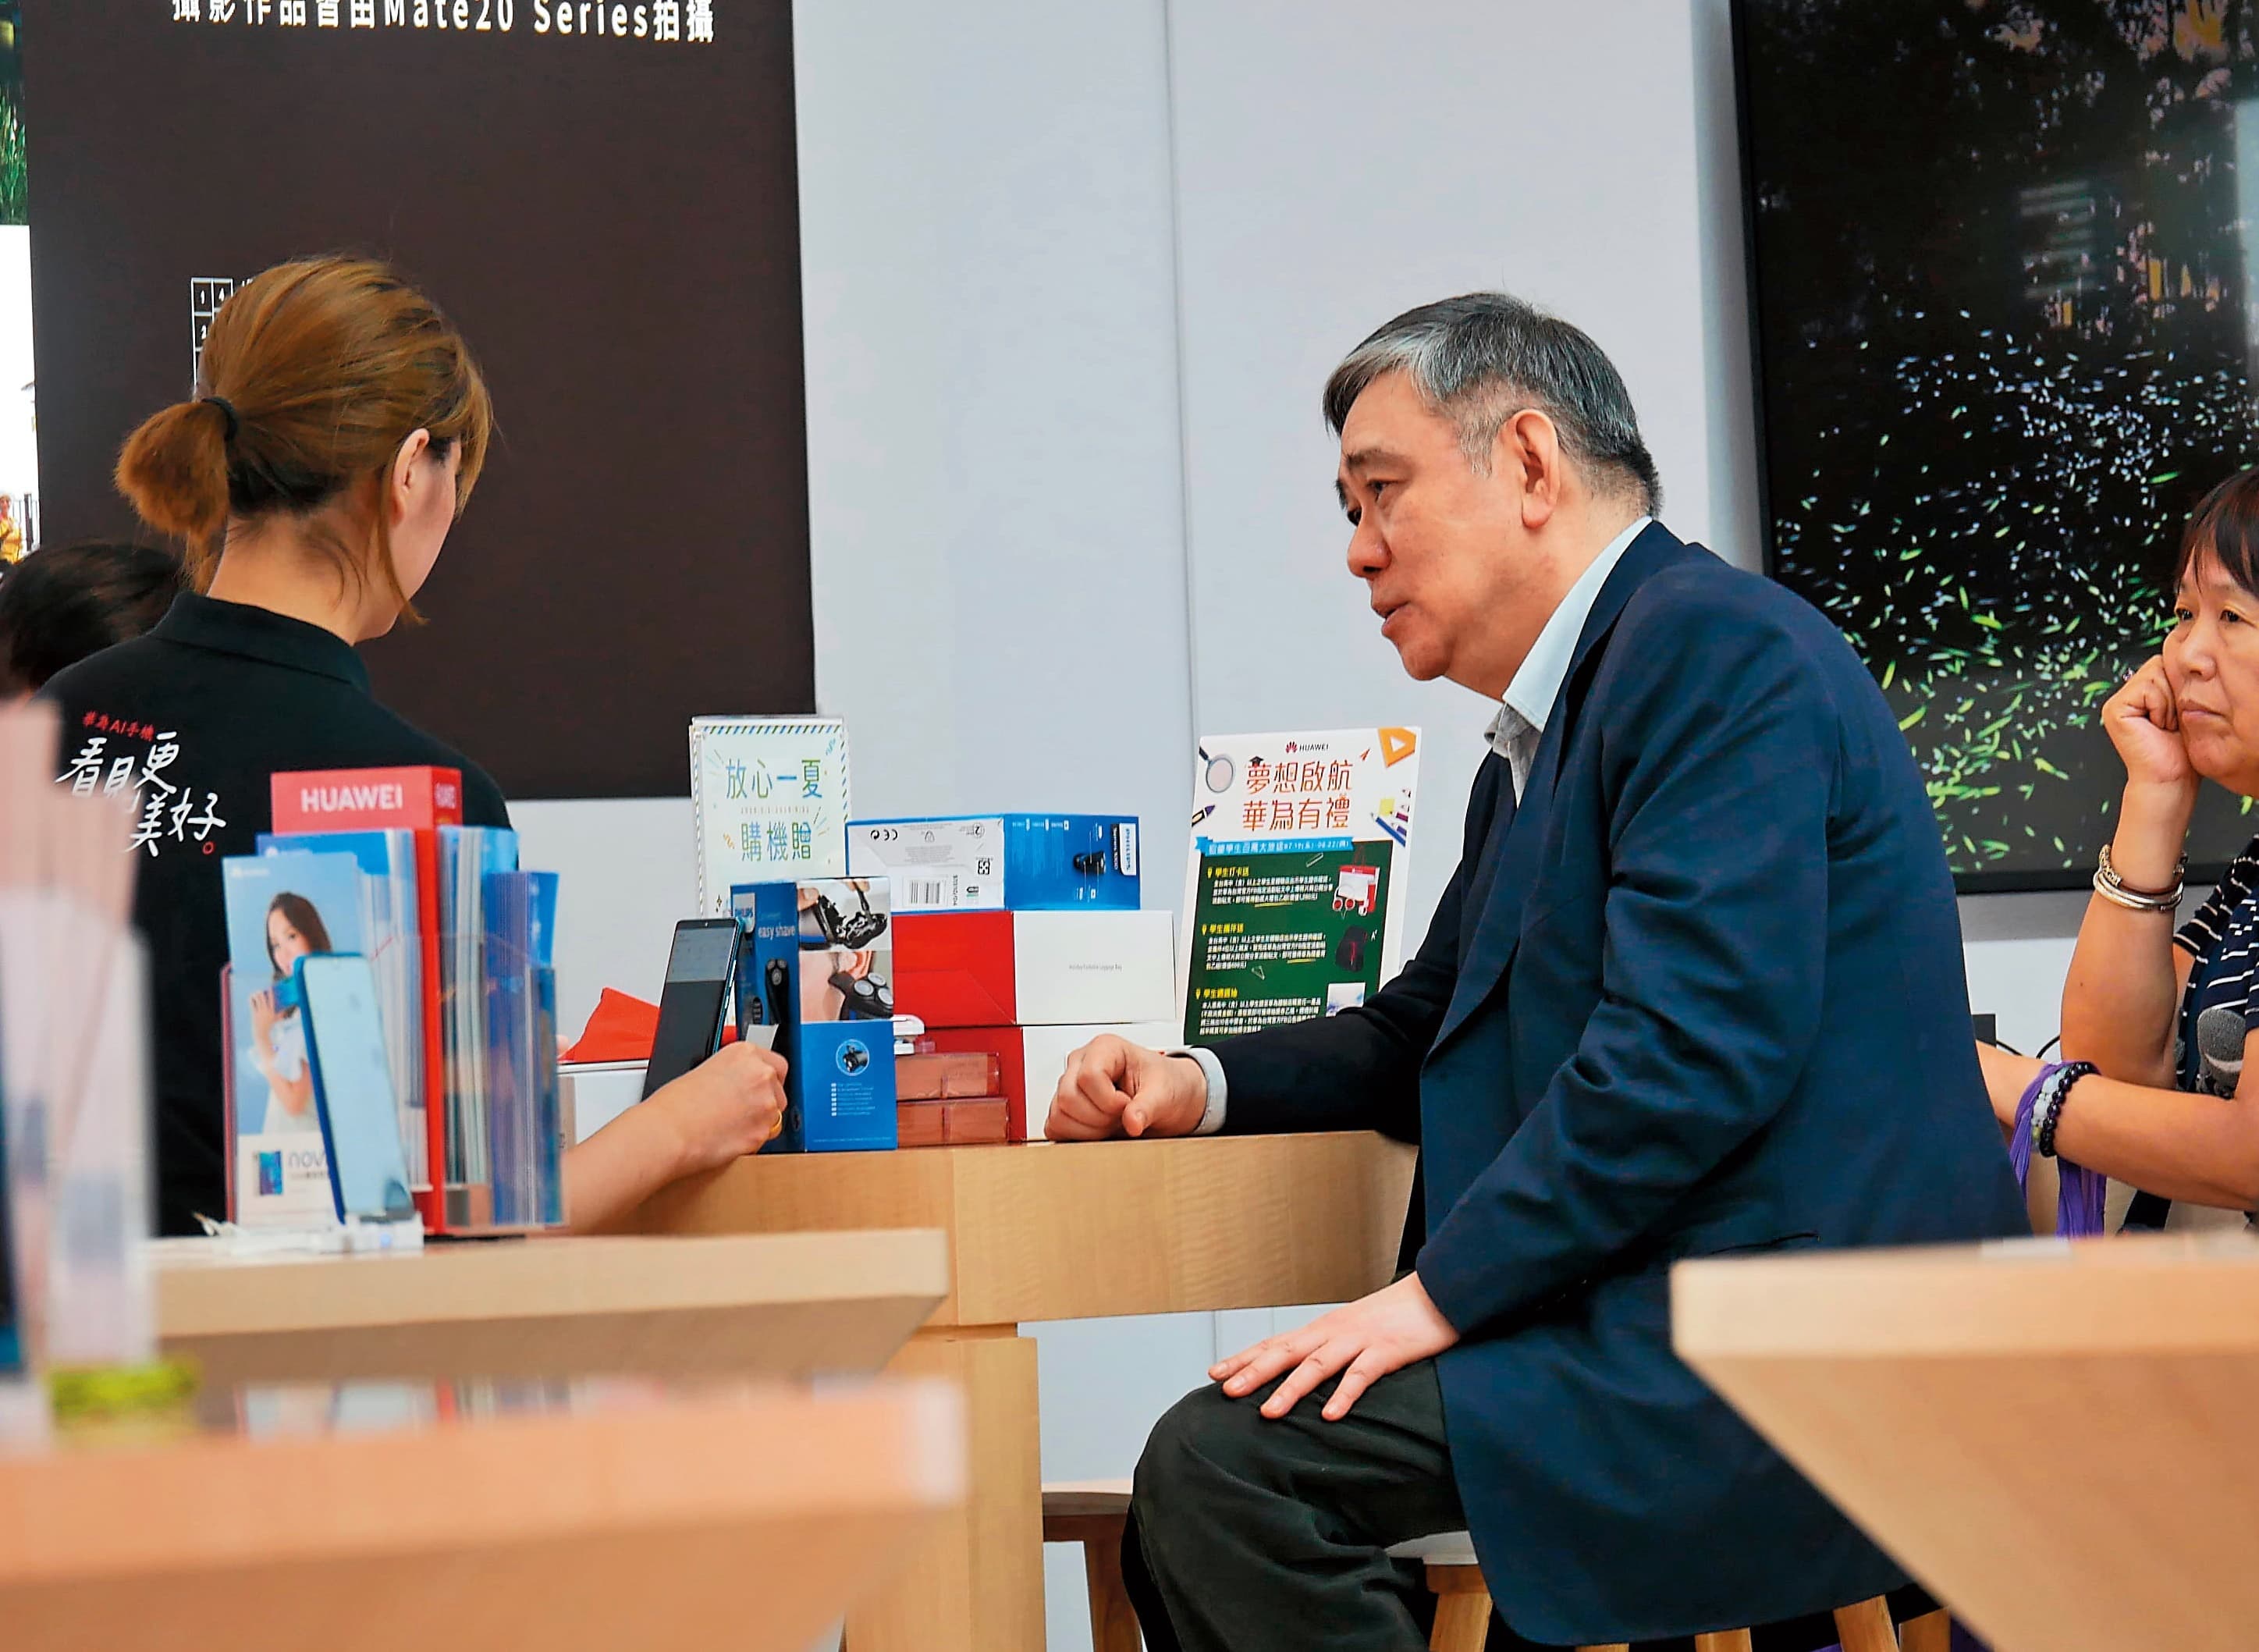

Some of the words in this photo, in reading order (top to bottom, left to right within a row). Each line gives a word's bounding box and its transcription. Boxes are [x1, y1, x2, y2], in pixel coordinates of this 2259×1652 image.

[1299, 743, 1329, 752] HUAWEI
[726, 758, 822, 800] 放心一夏
[1246, 759, 1353, 794] 夢想啟航
[300, 783, 403, 813] HUAWEI
[1242, 794, 1351, 832] 華為有禮
[741, 821, 812, 862] 購機贈
[758, 926, 774, 940] easy
[775, 922, 796, 937] shave
[288, 1151, 326, 1168] nov
